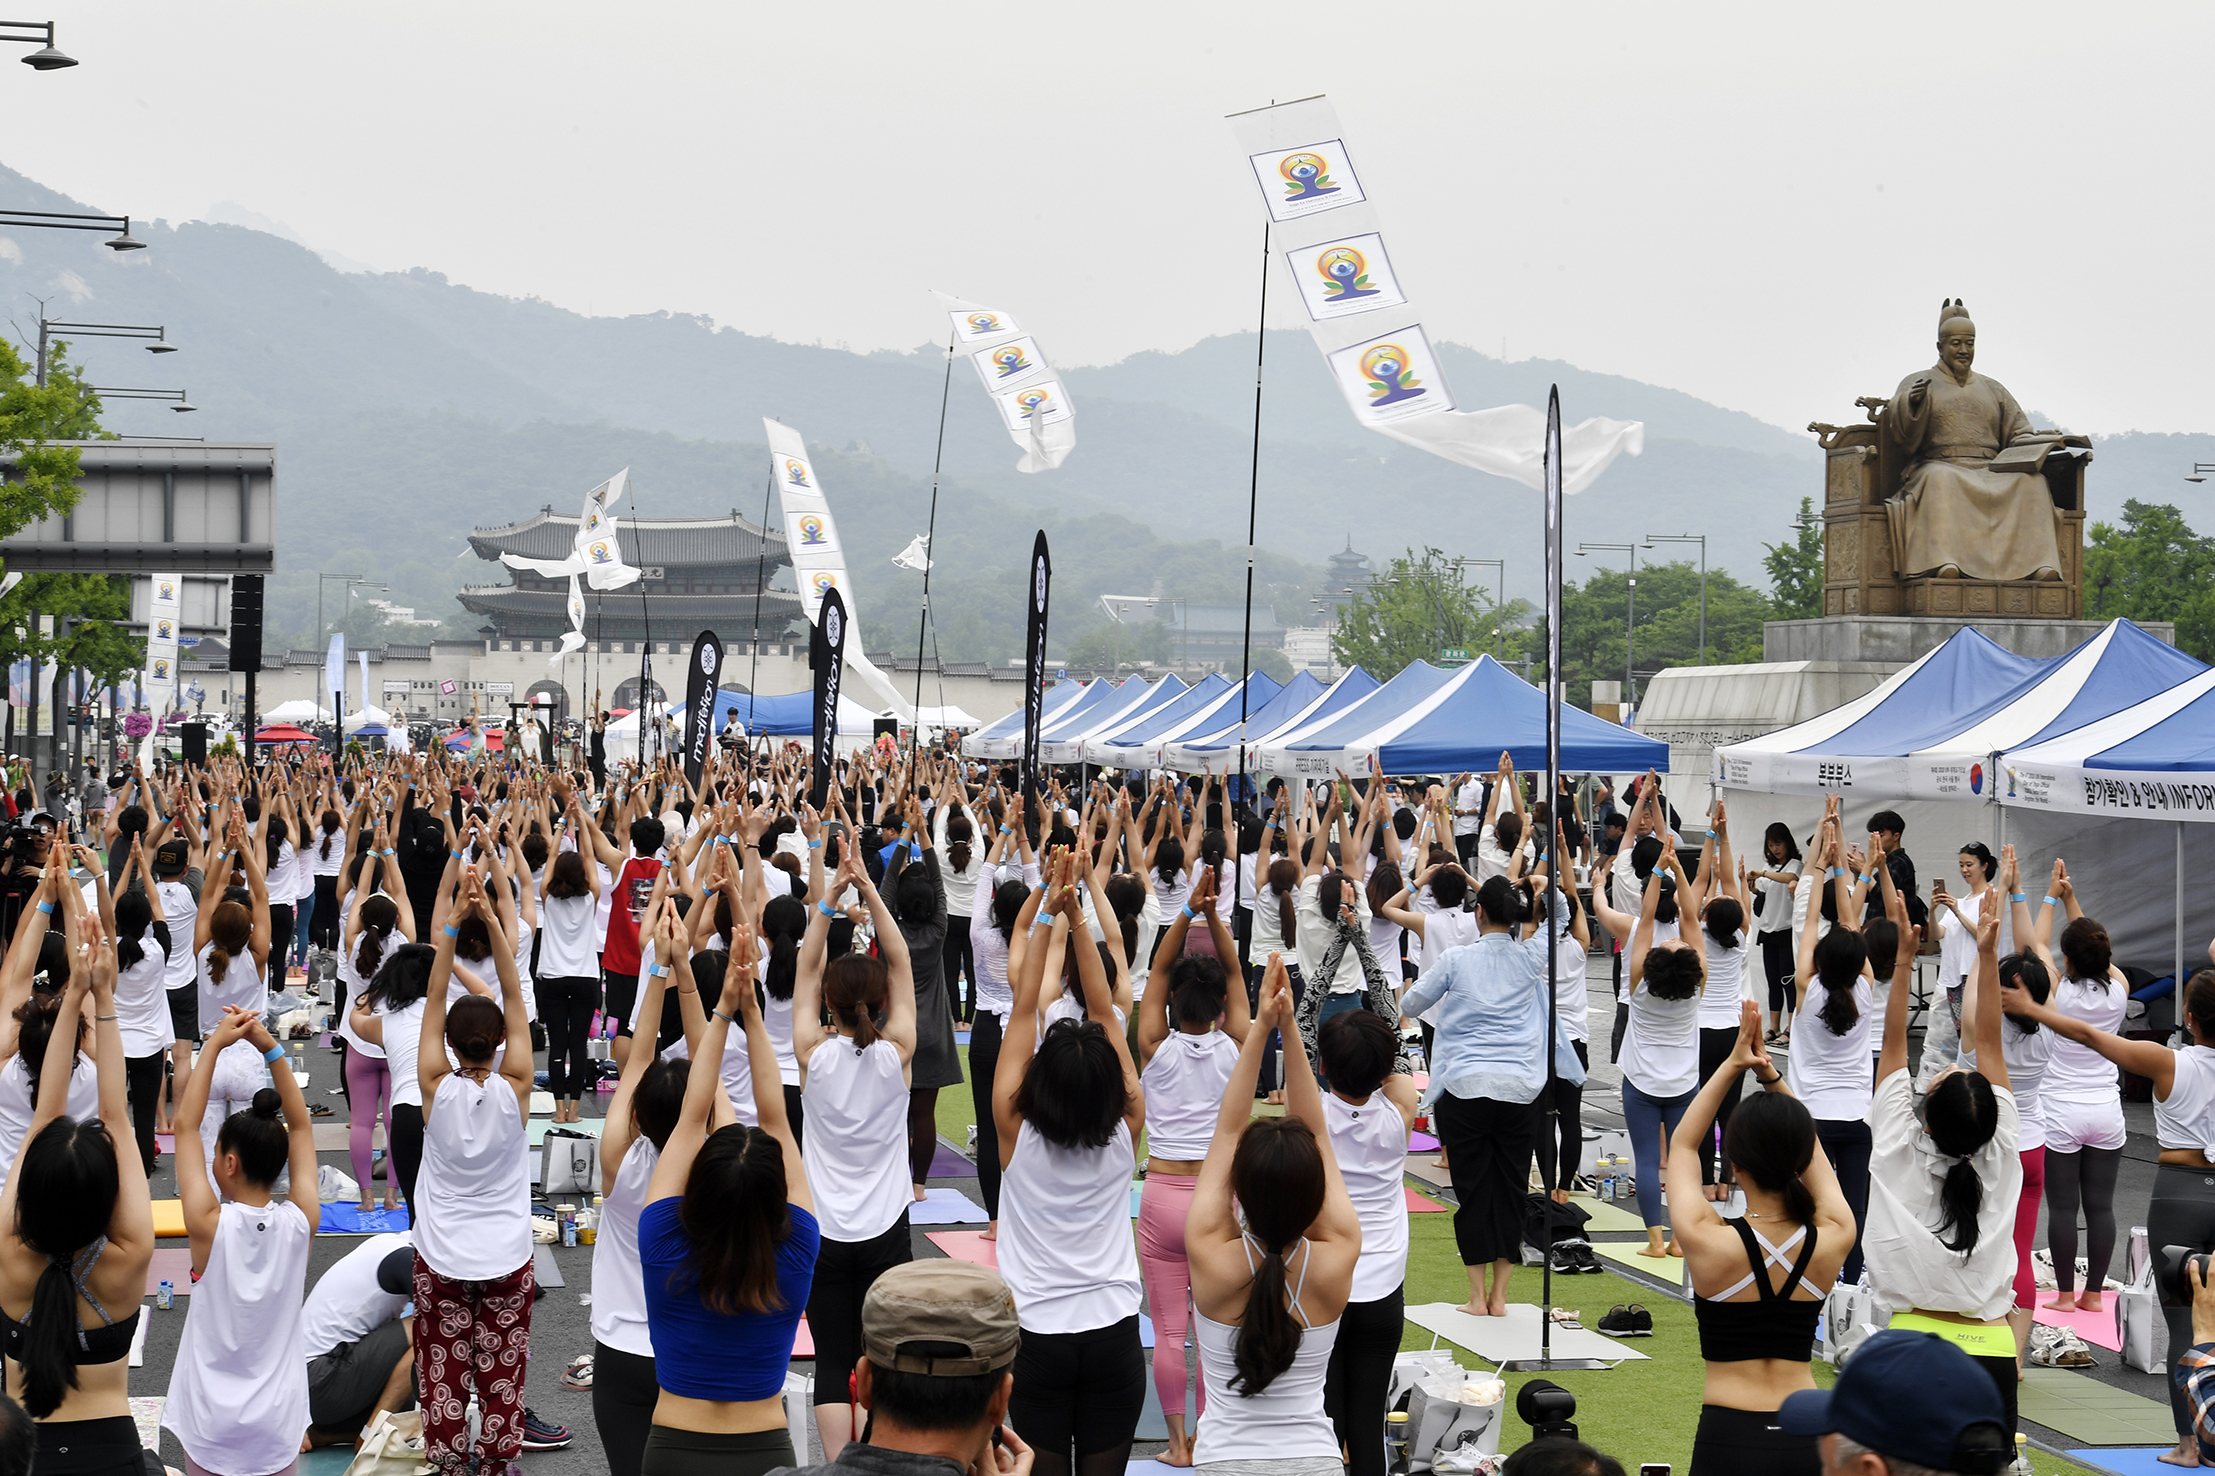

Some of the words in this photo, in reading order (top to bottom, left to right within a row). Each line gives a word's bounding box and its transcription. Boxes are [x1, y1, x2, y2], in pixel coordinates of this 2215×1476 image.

[1819, 762, 1852, 788] 본부부스
[2084, 777, 2129, 808] 참가확인
[2129, 781, 2142, 807] &
[2141, 781, 2169, 810] 안내
